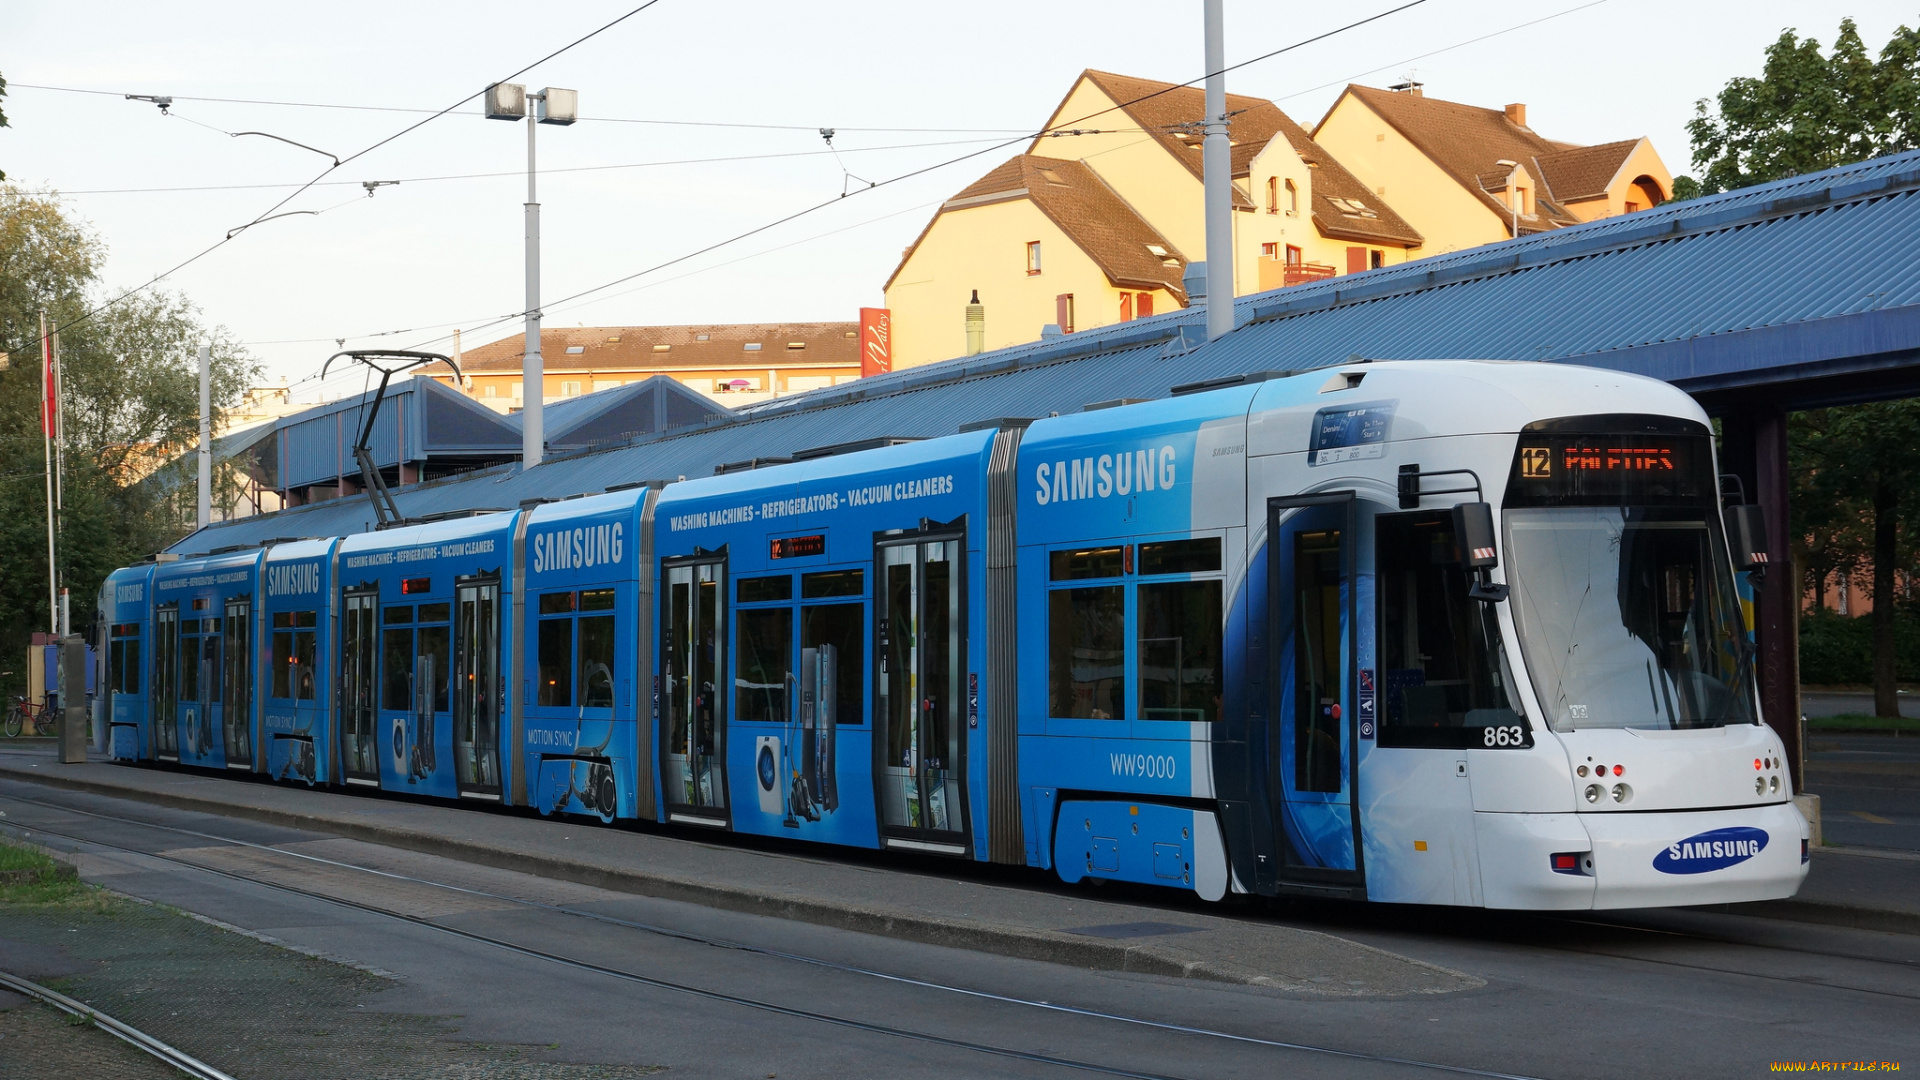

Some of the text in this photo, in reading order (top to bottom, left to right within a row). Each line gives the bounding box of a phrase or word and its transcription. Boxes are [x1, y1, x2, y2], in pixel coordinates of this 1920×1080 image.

[1212, 444, 1245, 457] SAMSUNG
[1523, 449, 1550, 476] 12
[1036, 445, 1176, 506] SAMSUNG
[670, 512, 708, 532] WASHING
[709, 505, 754, 526] MACHINES
[762, 492, 838, 519] REFRIGERATORS
[848, 484, 892, 507] VACUUM
[894, 474, 953, 501] CLEANERS
[347, 555, 368, 568] WASHING
[369, 552, 393, 566] MACHINES
[397, 547, 437, 563] REFRIGERATORS
[441, 543, 464, 558] VACUUM
[465, 539, 494, 555] CLEANERS
[534, 521, 623, 573] SAMSUNG
[268, 562, 319, 597] SAMSUNG
[117, 583, 143, 604] SAMSUNG
[1570, 704, 1588, 719] 09
[528, 729, 573, 747] MOTION SYNC
[1484, 725, 1523, 747] 863
[1110, 752, 1176, 779] WW9000
[1668, 839, 1759, 861] SAMSUNG
